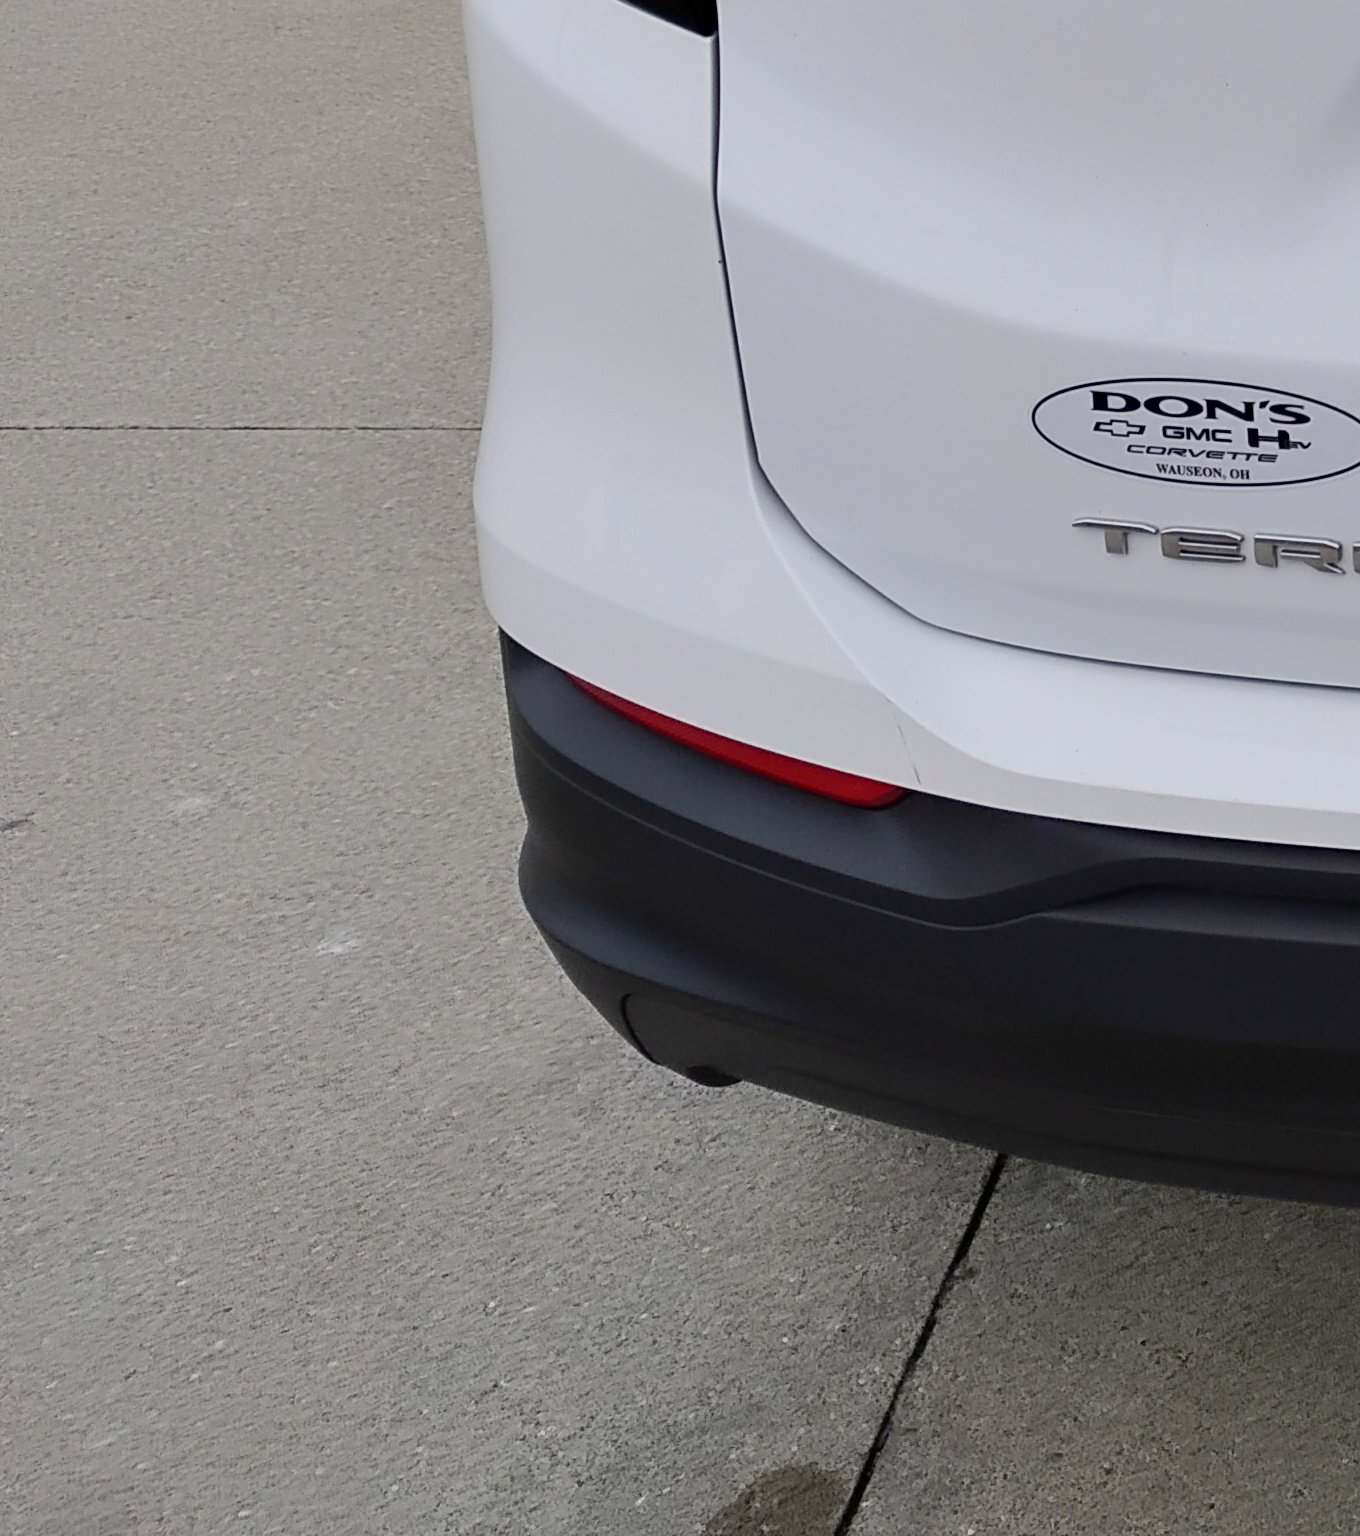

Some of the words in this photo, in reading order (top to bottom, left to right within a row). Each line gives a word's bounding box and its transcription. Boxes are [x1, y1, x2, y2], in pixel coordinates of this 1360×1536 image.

[1090, 390, 1312, 425] DON'S
[1161, 425, 1233, 443] GMC
[1126, 444, 1279, 463] CORVETTE
[1156, 463, 1228, 480] WAUSEON,
[1229, 468, 1251, 480] OH
